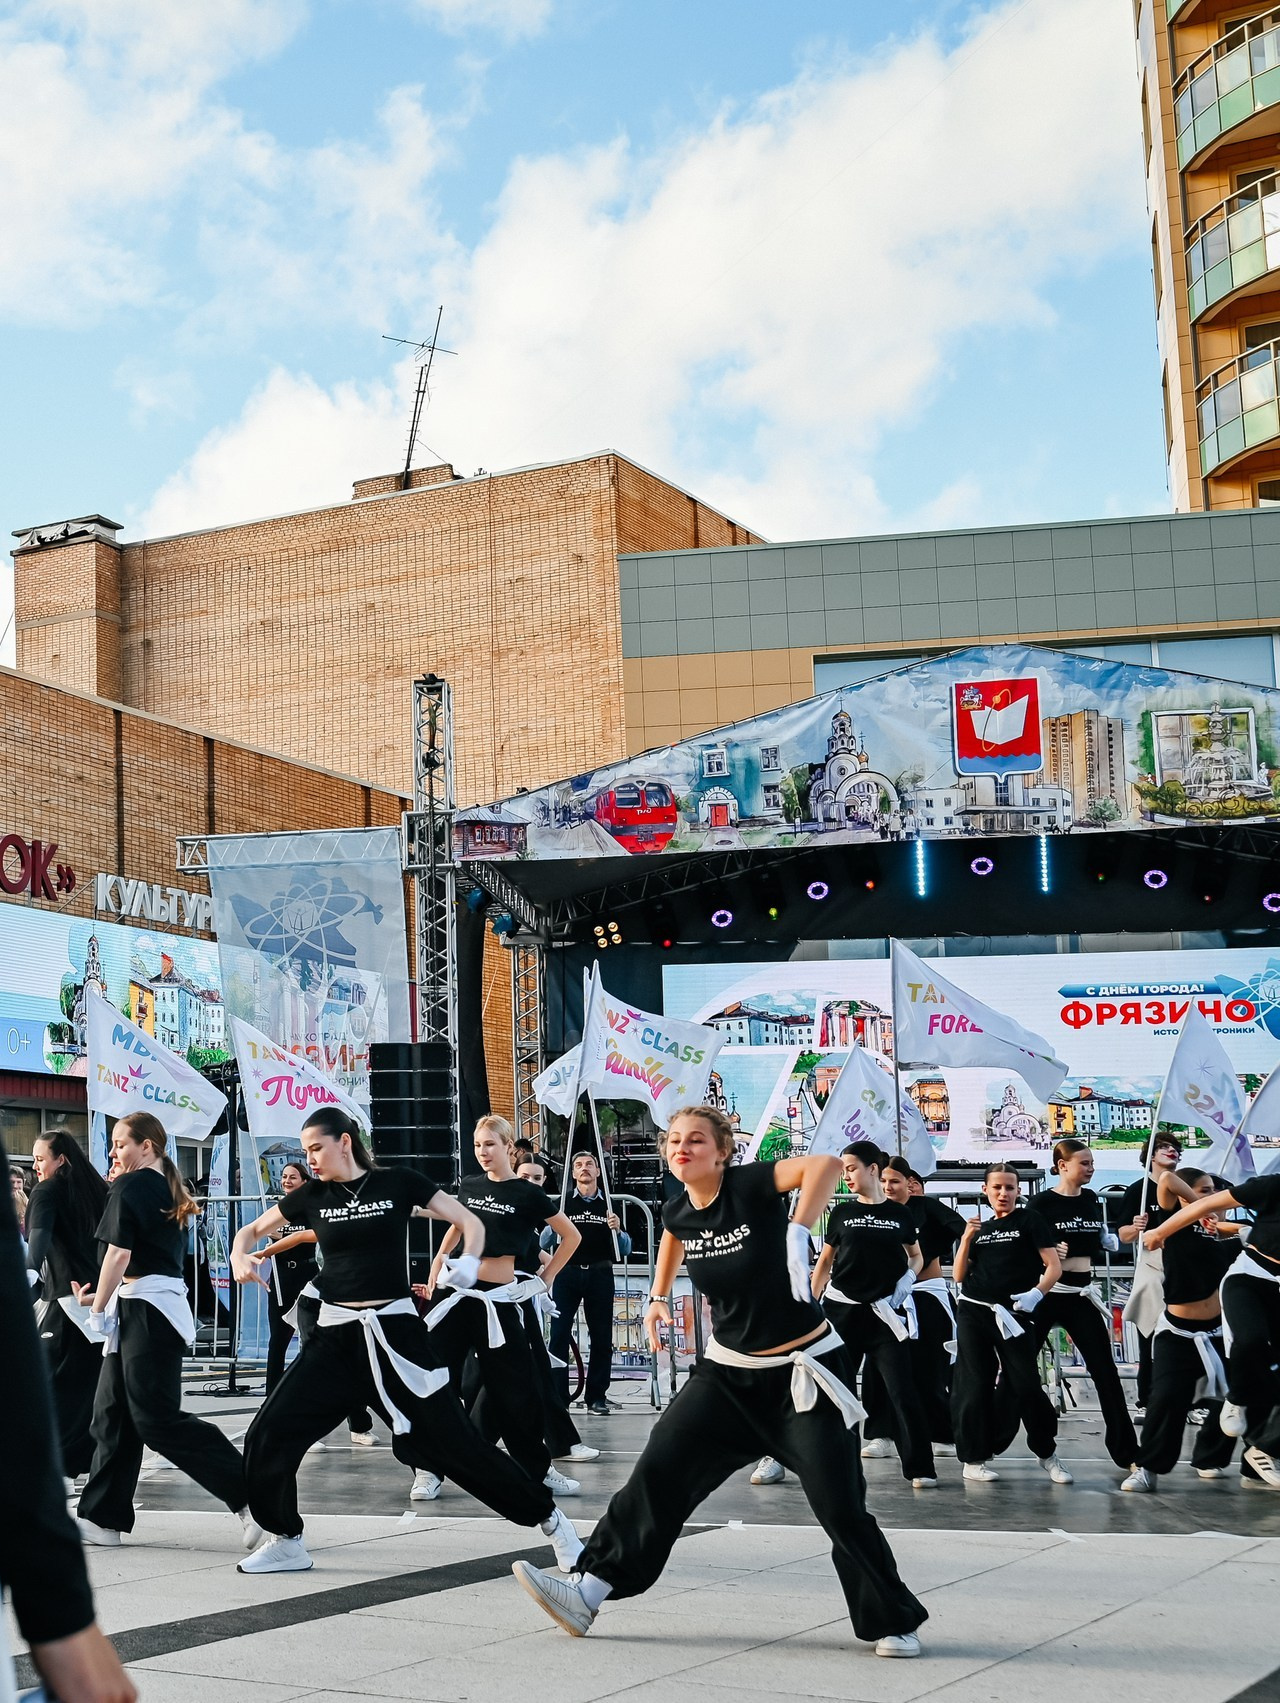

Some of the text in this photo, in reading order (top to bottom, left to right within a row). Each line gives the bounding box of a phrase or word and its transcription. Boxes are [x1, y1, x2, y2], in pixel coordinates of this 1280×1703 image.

[1086, 984, 1204, 997] С ДНЁМ ГОРОДА!
[1061, 998, 1256, 1029] ФРЯЗИНО
[97, 1064, 129, 1093] TANZ
[320, 1208, 348, 1218] TANZ
[843, 1218, 866, 1227] TANZ
[1055, 1221, 1078, 1230] TANZ
